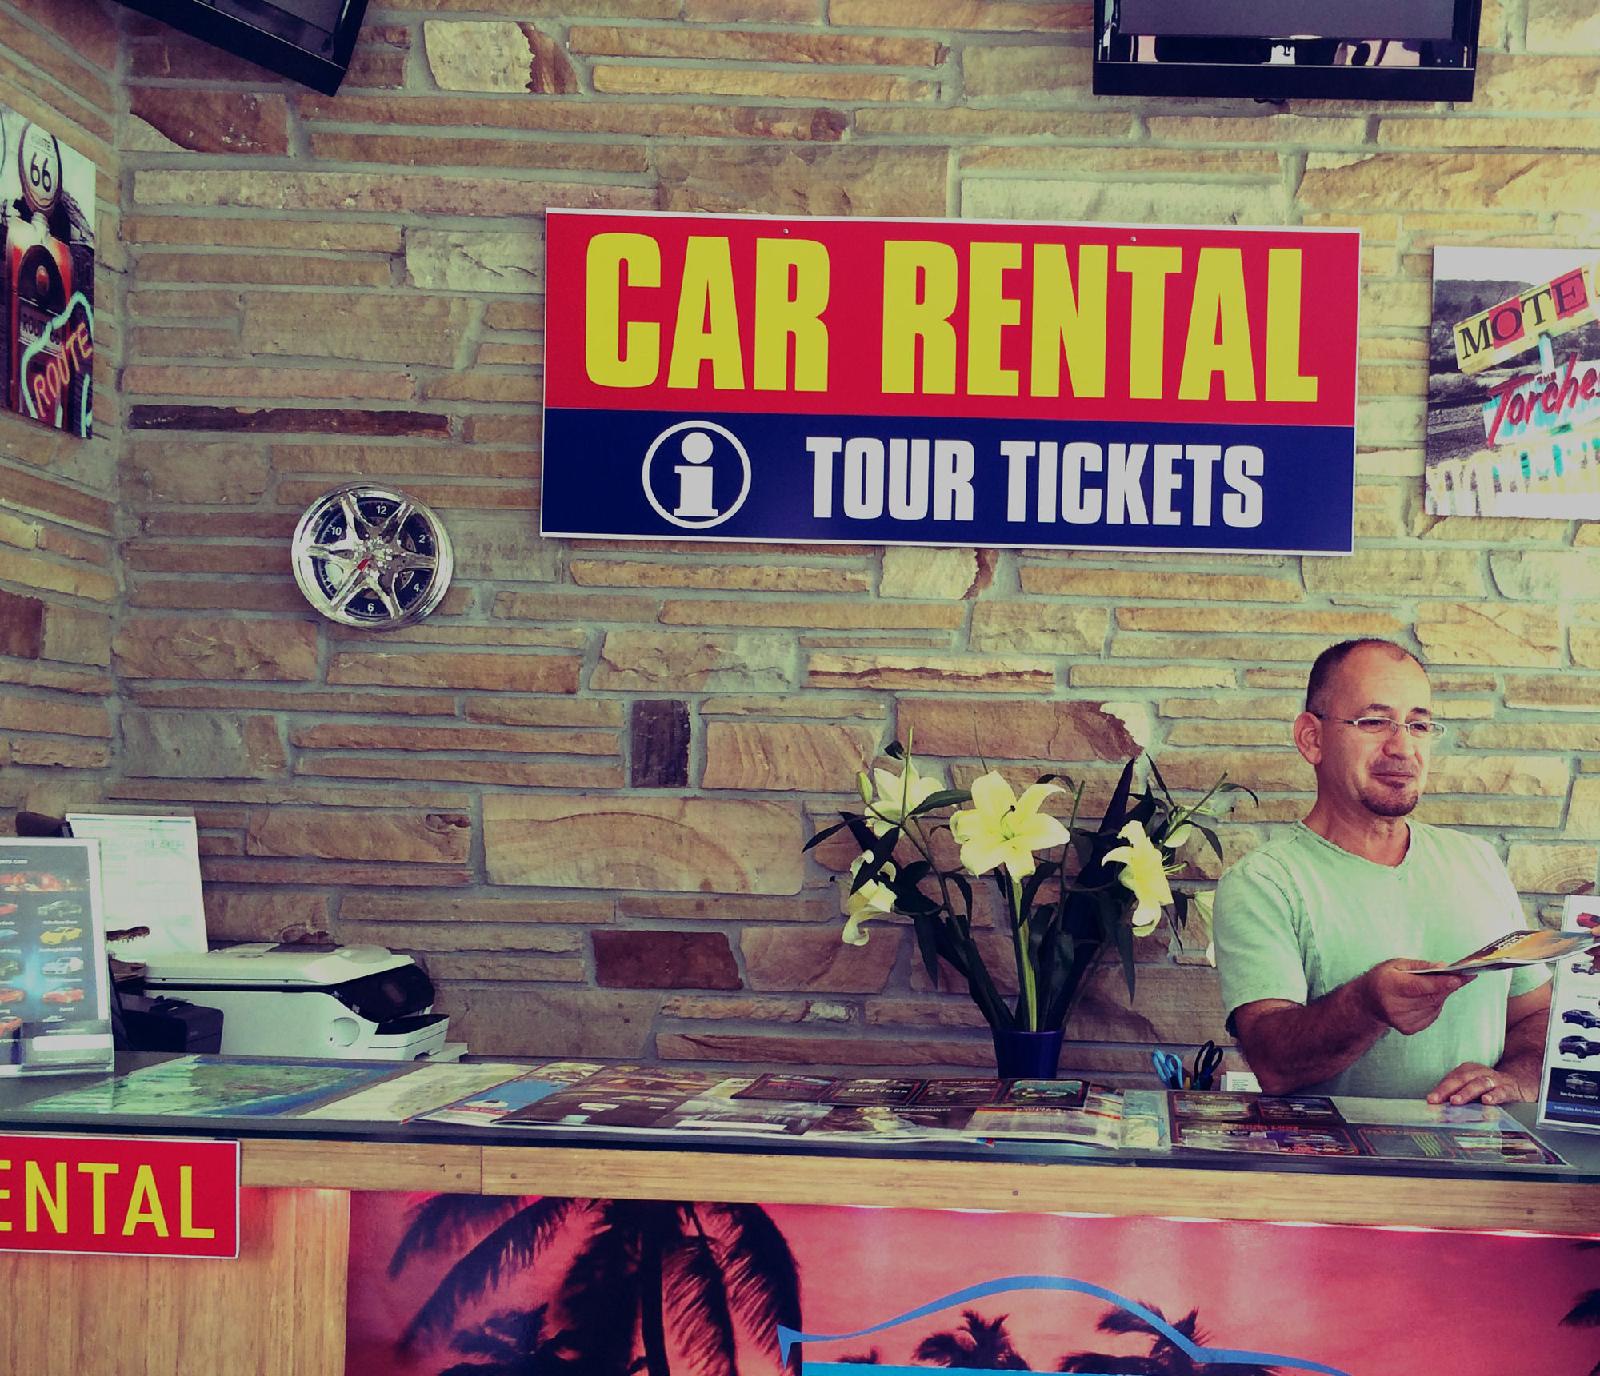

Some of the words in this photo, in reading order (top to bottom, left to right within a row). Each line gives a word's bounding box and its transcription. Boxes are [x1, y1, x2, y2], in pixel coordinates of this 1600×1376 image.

[30, 152, 52, 192] 66
[586, 233, 830, 391] CAR
[882, 241, 1320, 403] RENTAL
[1458, 270, 1589, 360] MOTE
[33, 322, 93, 418] ROUTE
[1486, 352, 1600, 448] Torche
[806, 437, 974, 521] TOUR
[1001, 442, 1264, 528] TICKETS
[375, 505, 388, 516] 12
[330, 526, 343, 537] 10
[417, 535, 426, 544] 2
[366, 602, 376, 613] 6
[412, 583, 421, 593] 4
